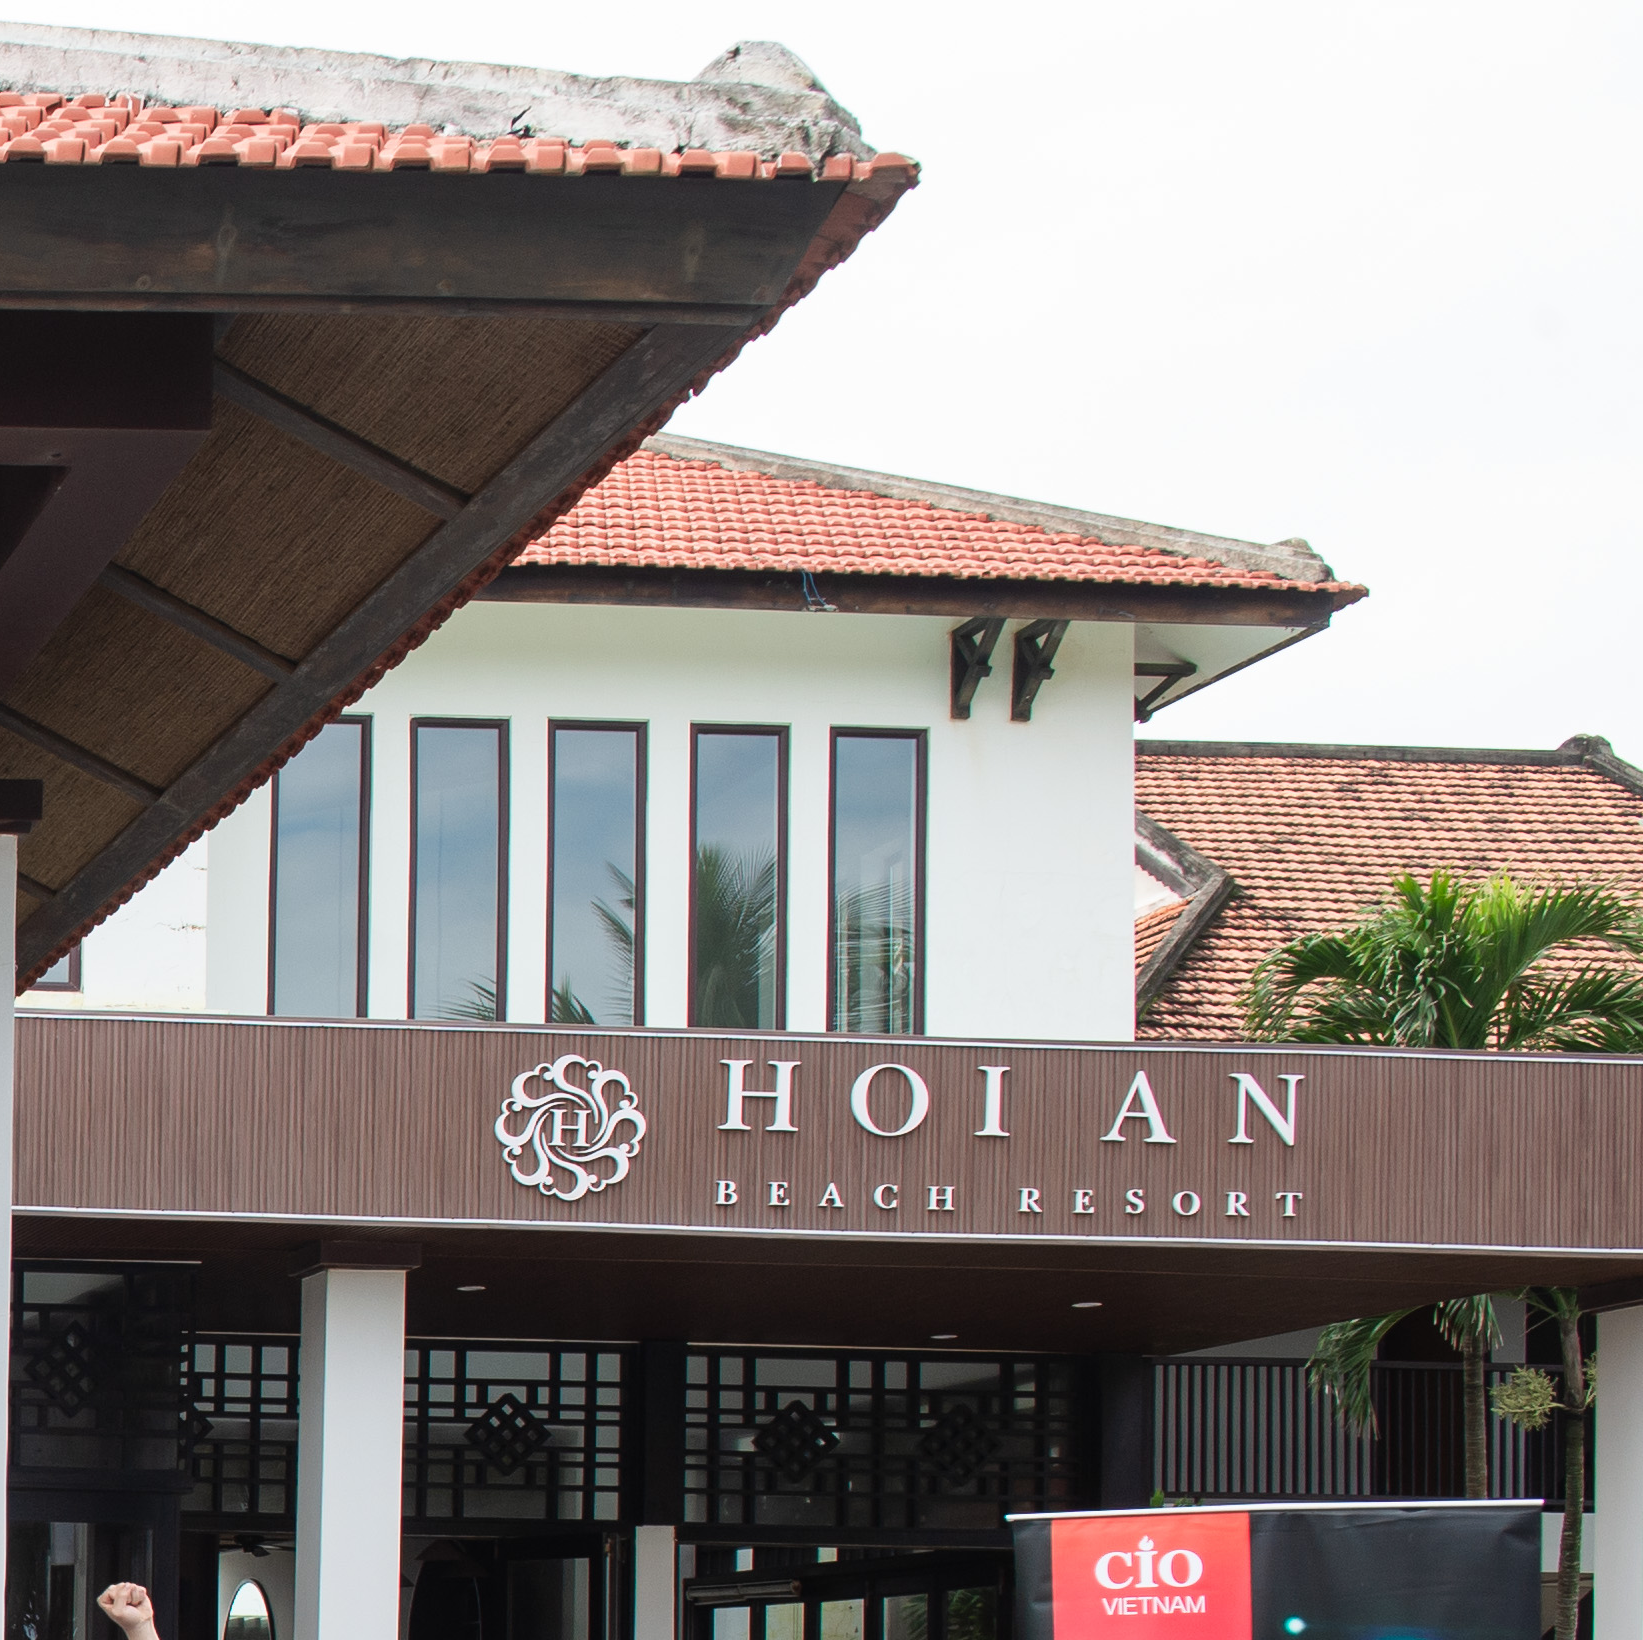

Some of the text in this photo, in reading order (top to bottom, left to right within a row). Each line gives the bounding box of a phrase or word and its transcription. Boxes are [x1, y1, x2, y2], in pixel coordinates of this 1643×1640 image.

[716, 1058, 1307, 1148] HOI AN
[716, 1179, 1305, 1219] BEACH RESORT
[1102, 1595, 1206, 1616] VIETNAM
